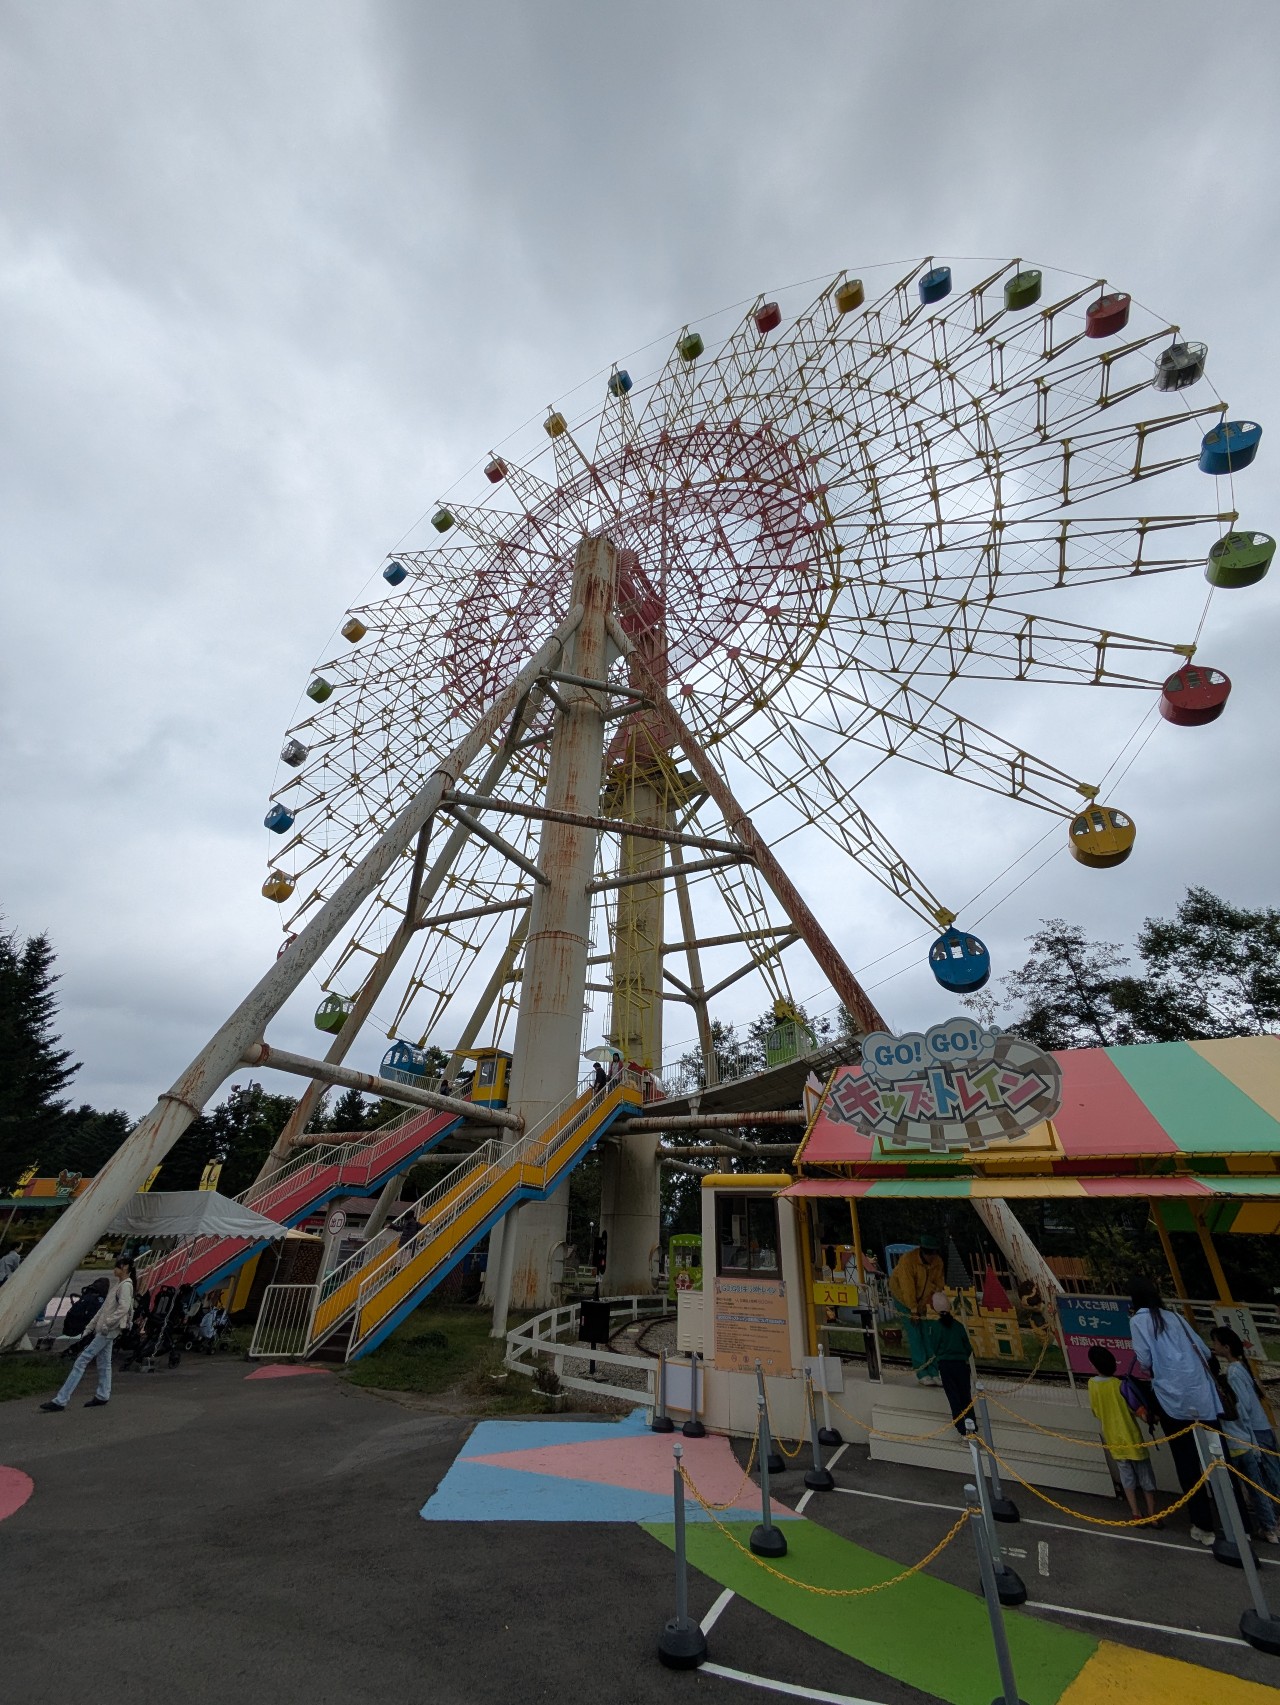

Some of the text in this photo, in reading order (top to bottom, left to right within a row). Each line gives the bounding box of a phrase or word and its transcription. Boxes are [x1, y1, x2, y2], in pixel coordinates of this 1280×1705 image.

[874, 1030, 978, 1066] GO! GO!
[837, 1067, 1042, 1120] キッズトレイン
[330, 1218, 343, 1228] 出口
[823, 1290, 848, 1304] 入口
[1067, 1299, 1120, 1312] 1人でご利用
